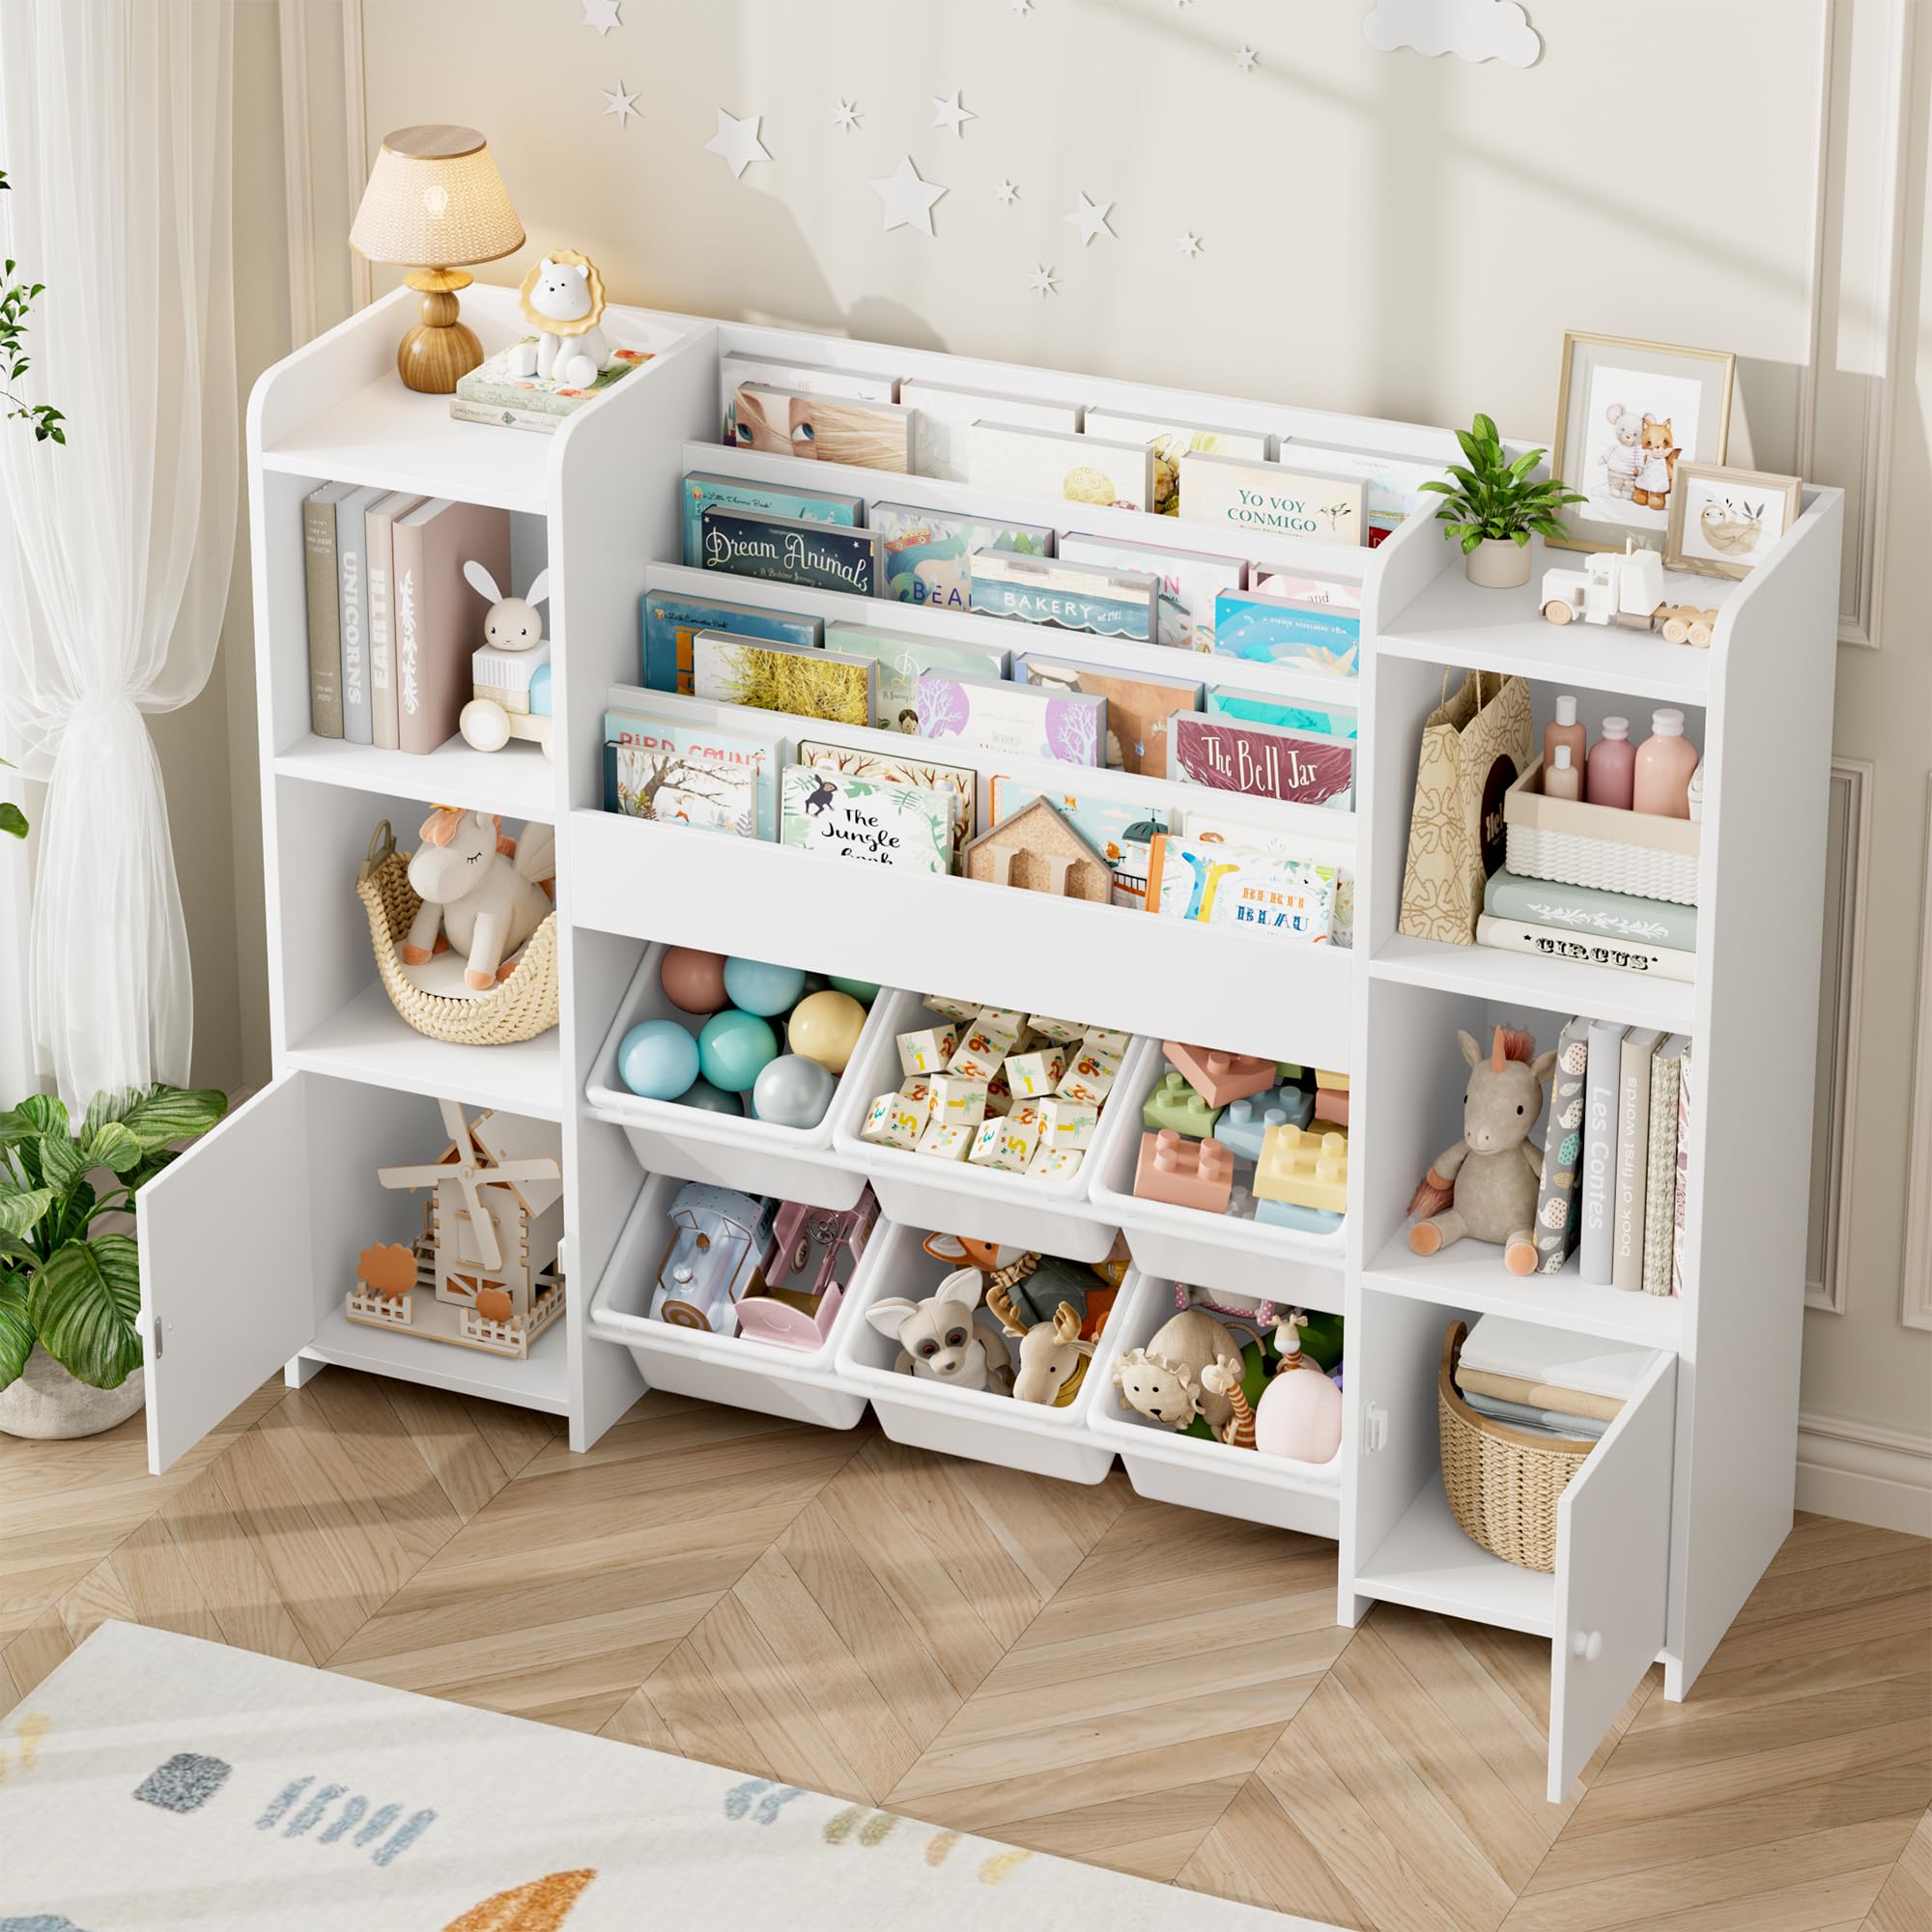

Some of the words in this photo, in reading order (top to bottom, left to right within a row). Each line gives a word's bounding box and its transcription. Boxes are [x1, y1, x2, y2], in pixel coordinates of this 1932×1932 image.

[1238, 489, 1264, 507] YO
[1269, 497, 1306, 514] VOY
[1227, 508, 1317, 532] CONMIGO
[705, 526, 780, 567] Dream
[783, 533, 868, 592] Animals
[913, 582, 972, 607] BEA
[1004, 591, 1093, 619] BAKERY
[343, 552, 361, 704] UNICORNS
[1201, 736, 1232, 777] The
[1237, 739, 1281, 800] Bell
[1288, 750, 1318, 788] Jar
[843, 809, 878, 827] The
[821, 822, 901, 852] Jungle
[1536, 938, 1649, 971] CIRCUS
[915, 1053, 925, 1071] 1
[1024, 1075, 1034, 1094] 1
[1593, 1088, 1612, 1131] Les
[1626, 1077, 1637, 1136] words
[1623, 1143, 1634, 1179] first
[1588, 1142, 1609, 1230] Contes
[1623, 1179, 1633, 1203] of
[1620, 1209, 1632, 1257] book
